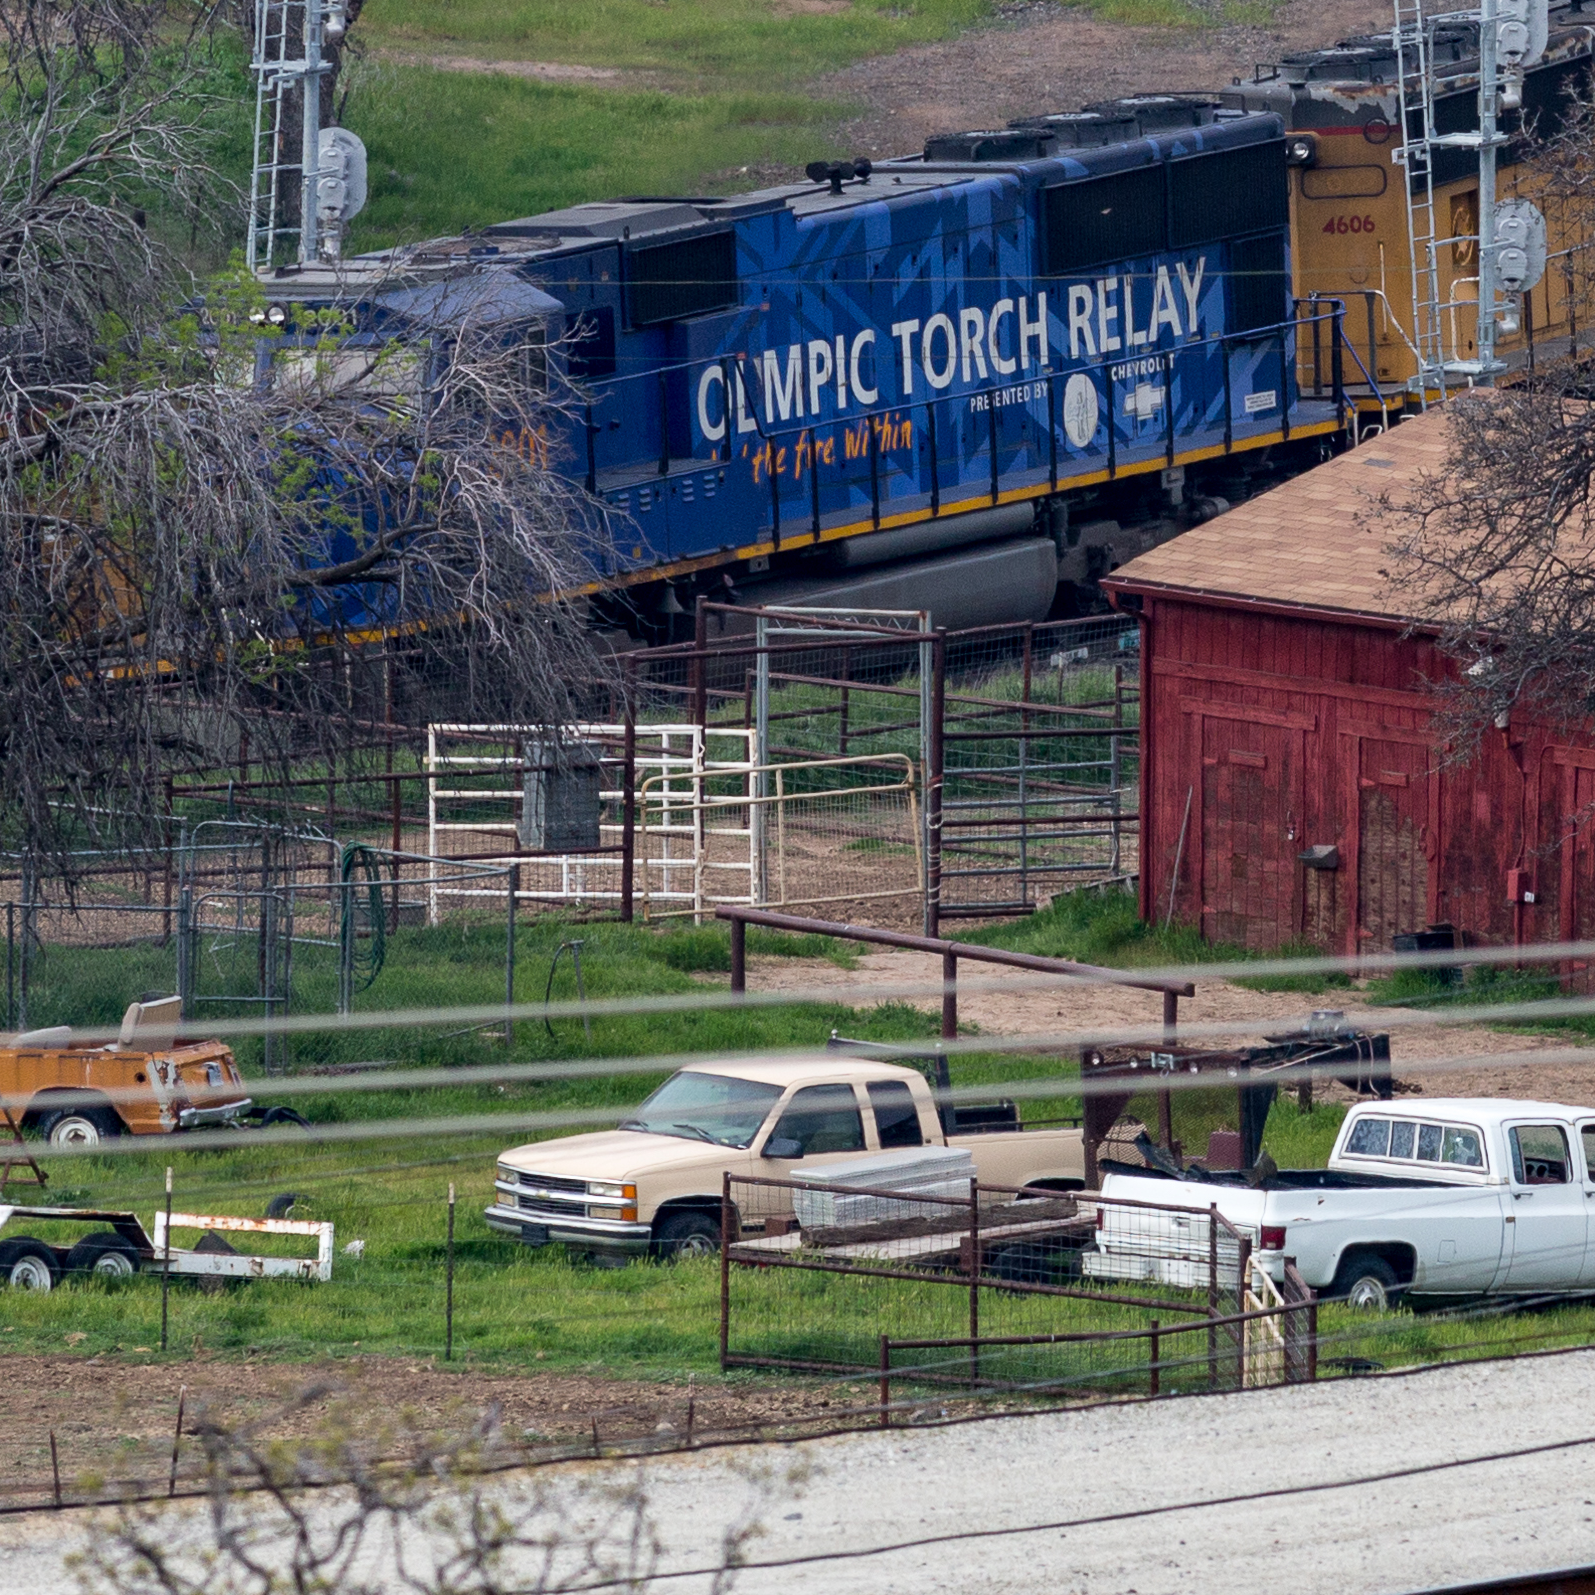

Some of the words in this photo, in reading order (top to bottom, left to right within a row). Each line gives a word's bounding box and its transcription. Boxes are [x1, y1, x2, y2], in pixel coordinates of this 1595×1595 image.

[1322, 215, 1376, 235] 4606
[892, 292, 1049, 395] TORCH
[1068, 256, 1206, 359] RELAY
[1034, 381, 1048, 399] BY
